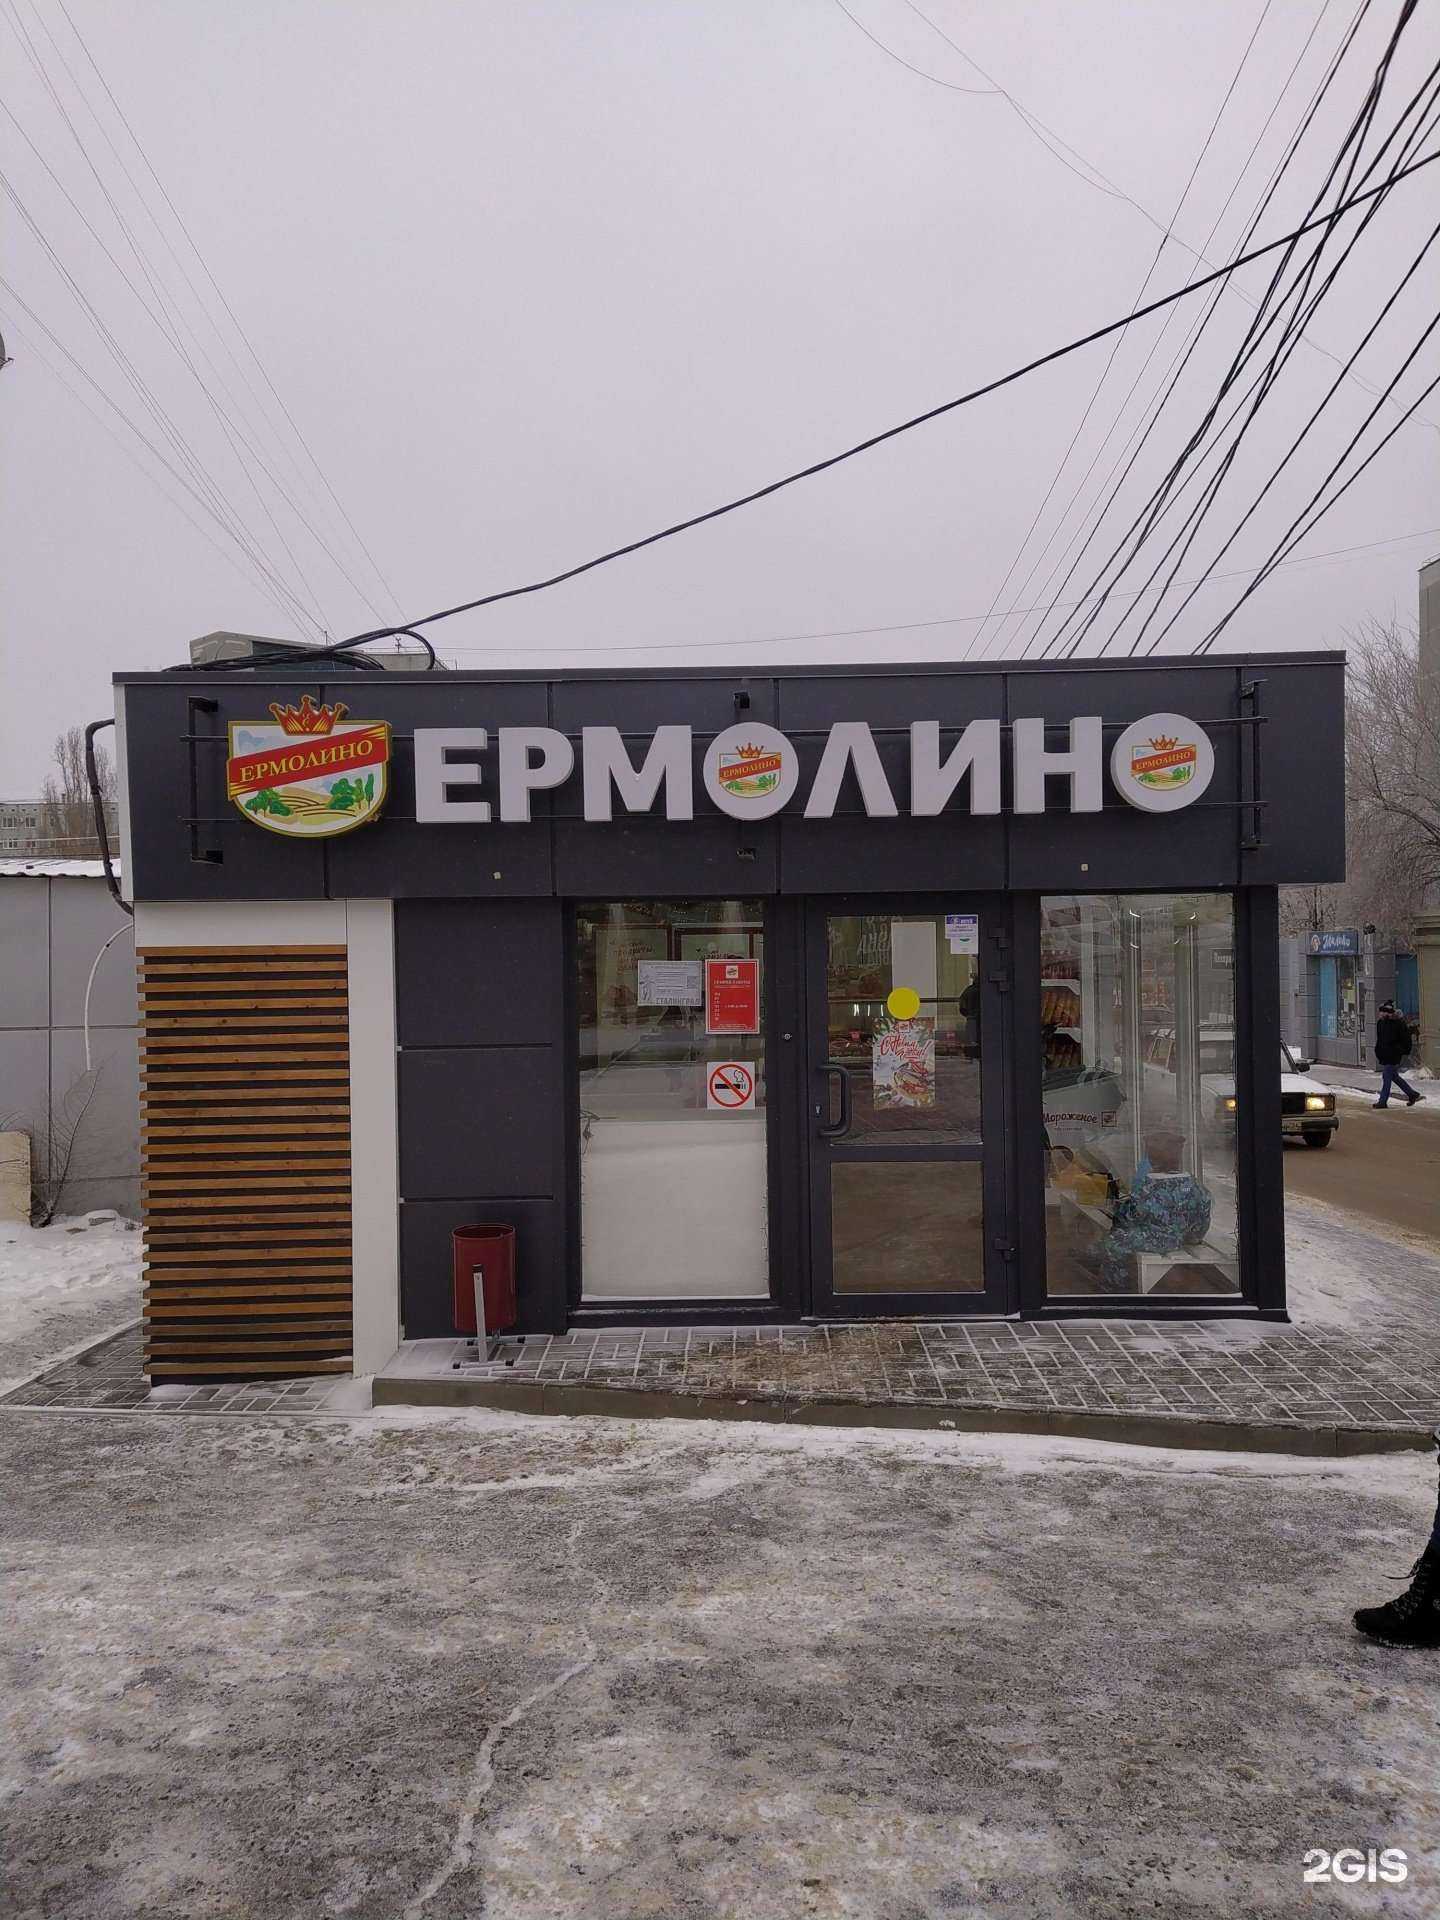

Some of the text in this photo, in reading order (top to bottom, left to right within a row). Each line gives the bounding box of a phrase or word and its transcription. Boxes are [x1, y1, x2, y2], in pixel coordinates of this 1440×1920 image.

[239, 739, 373, 783] ЕРМОЛИНО
[413, 712, 1214, 823] ЕРМОЛИНО
[1135, 750, 1191, 771] ЕРМОЛИНО
